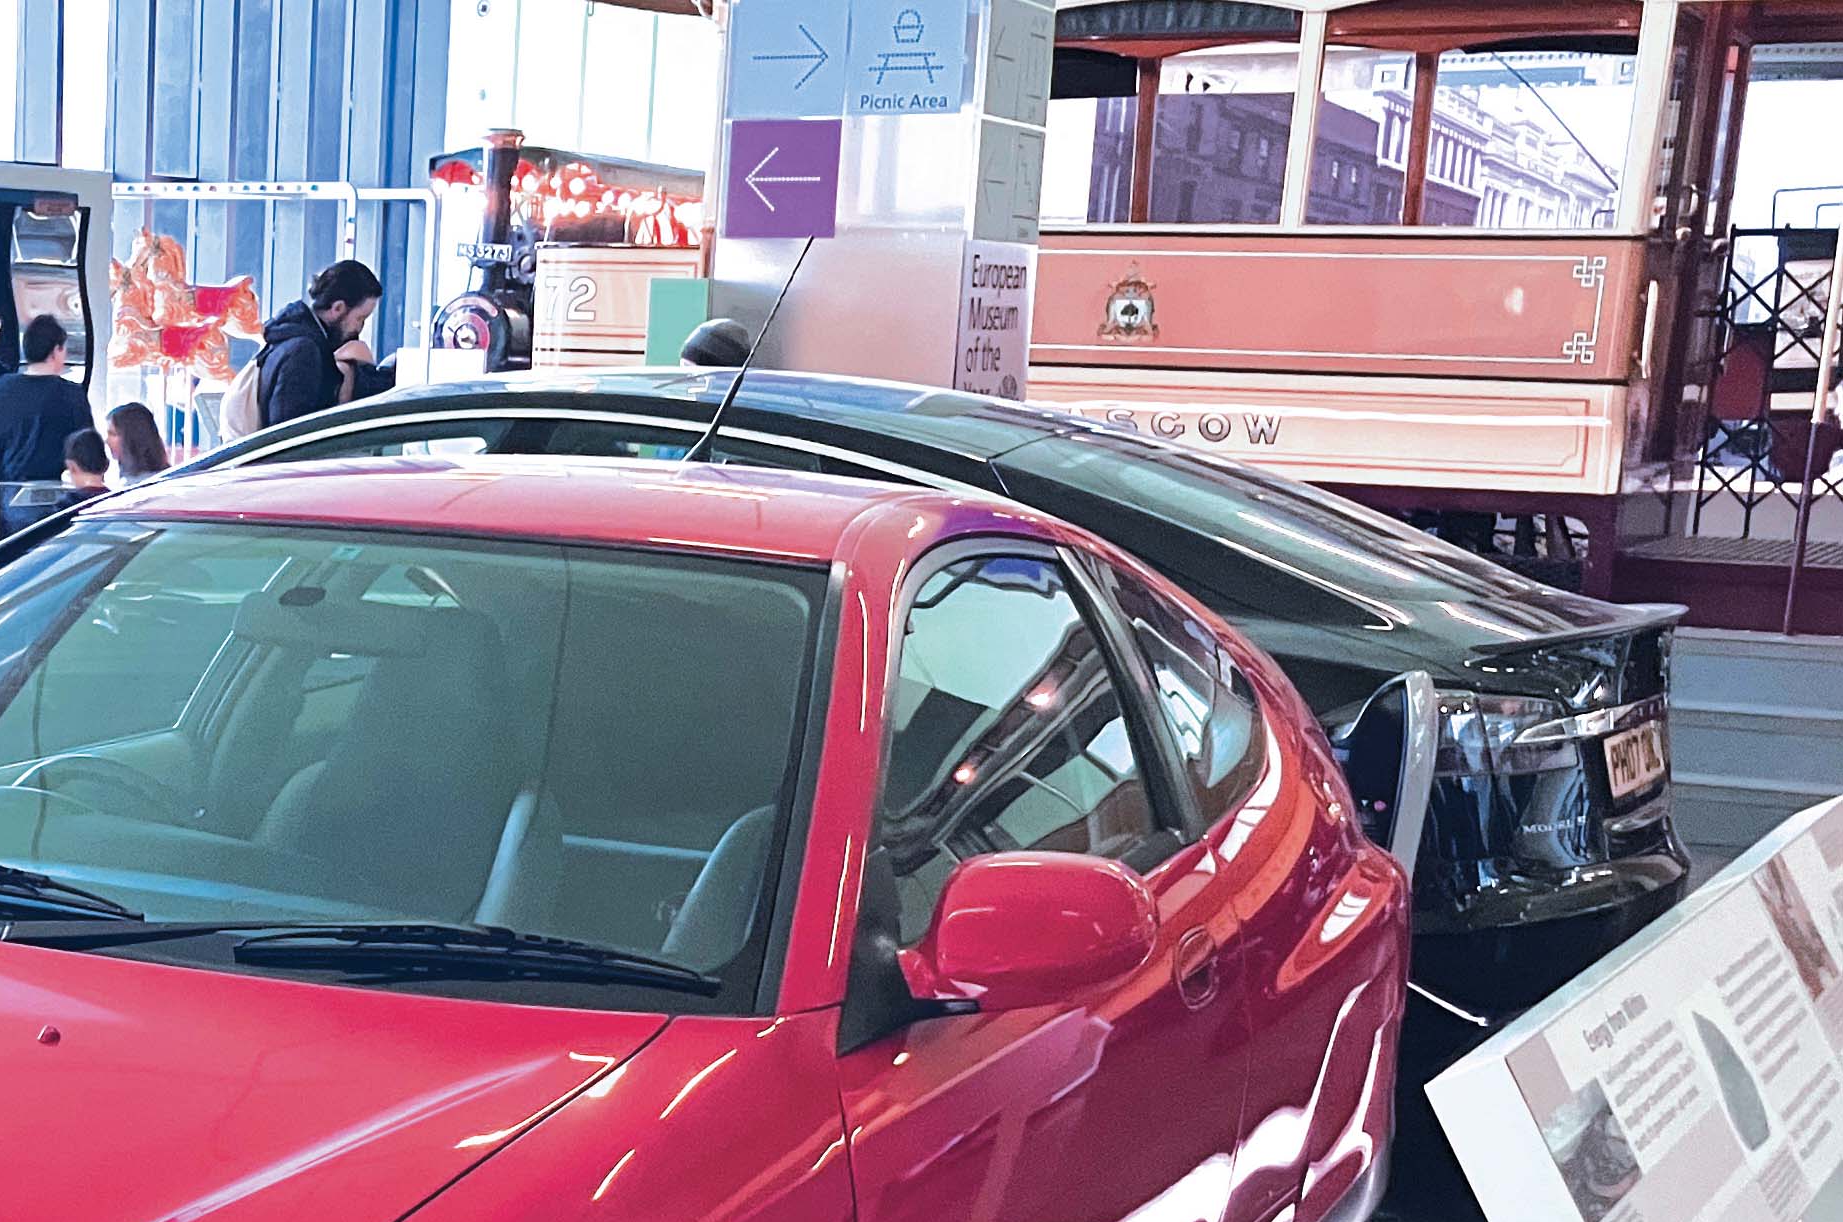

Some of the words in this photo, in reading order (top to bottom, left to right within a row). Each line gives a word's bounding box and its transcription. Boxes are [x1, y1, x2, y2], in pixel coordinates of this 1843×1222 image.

[860, 94, 905, 109] Picnic
[909, 95, 948, 109] Area
[972, 253, 1027, 298] European
[545, 276, 597, 322] 72
[969, 297, 1018, 331] Museum
[965, 336, 981, 373] of
[982, 337, 1001, 372] the
